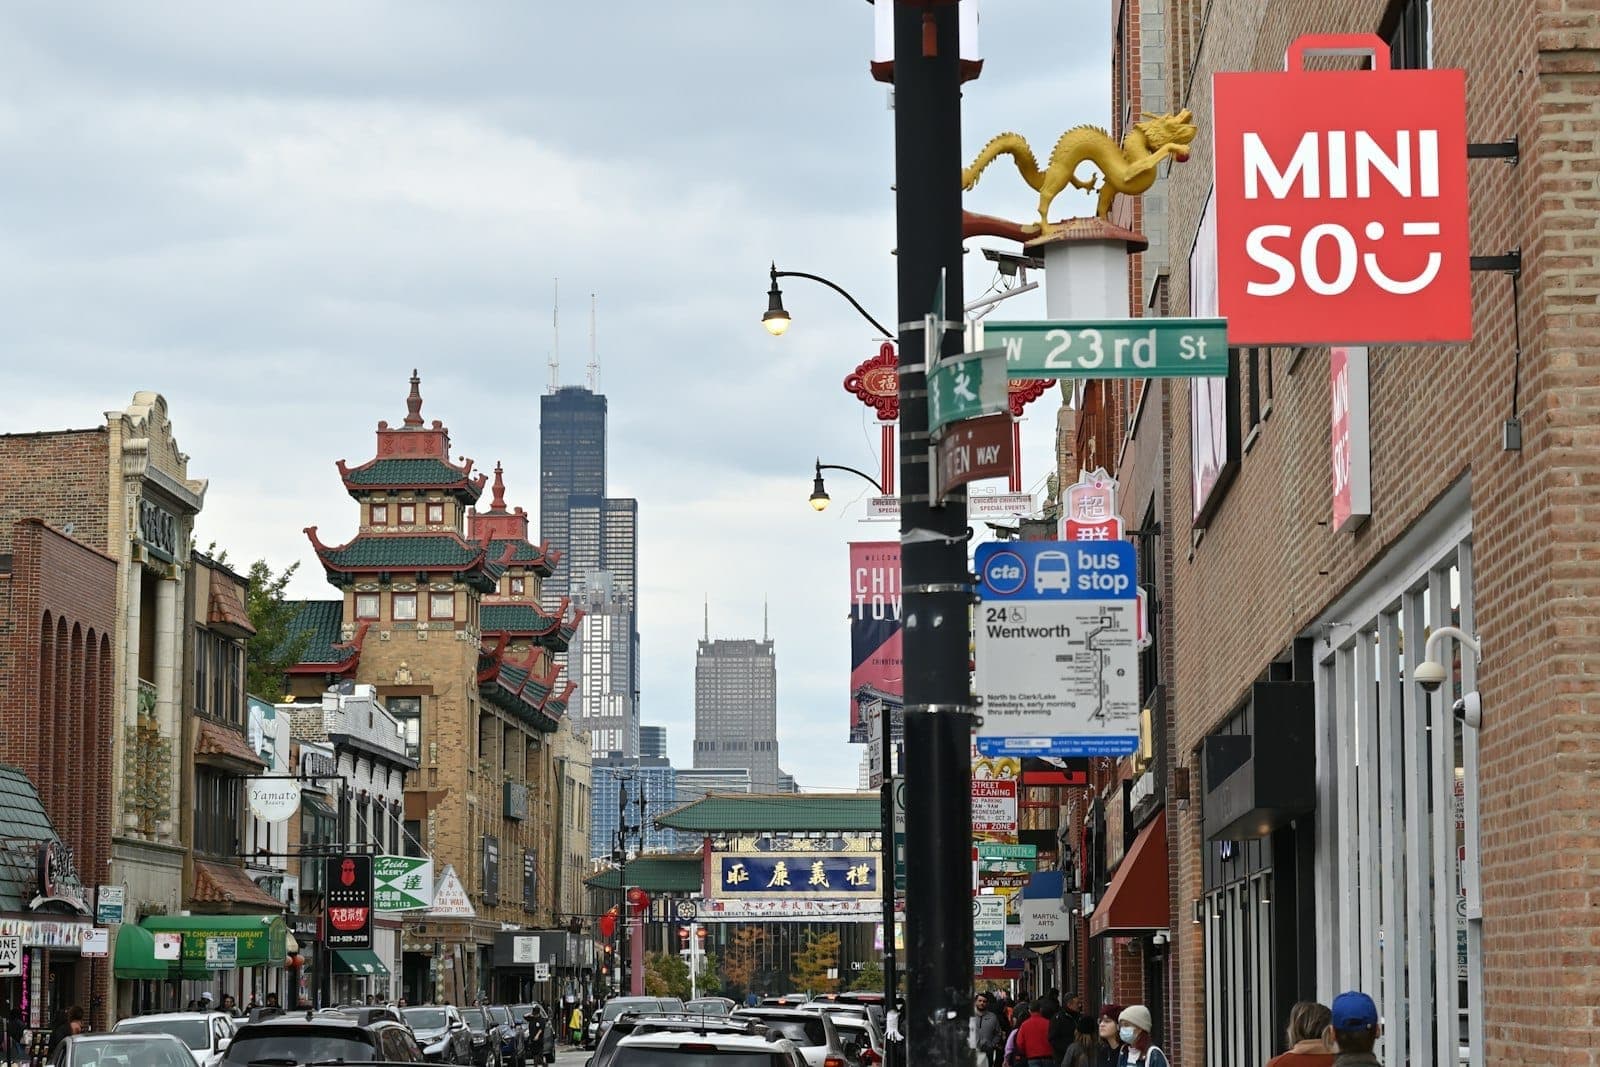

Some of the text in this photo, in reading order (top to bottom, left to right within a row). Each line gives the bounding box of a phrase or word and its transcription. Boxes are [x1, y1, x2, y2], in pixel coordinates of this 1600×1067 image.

[1243, 129, 1440, 200] MINI
[1002, 328, 1207, 369] W 23rd St
[976, 444, 1001, 466] WAY
[990, 550, 1121, 580] cta bus
[1077, 571, 1129, 595] stop
[986, 607, 1007, 622] 24
[986, 624, 1071, 638] Wentworth
[971, 781, 999, 789] STREET
[971, 788, 1011, 796] CLEANING
[253, 790, 297, 801] Yamato
[980, 846, 1027, 857] WENTWORTH
[0, 939, 17, 949] NE
